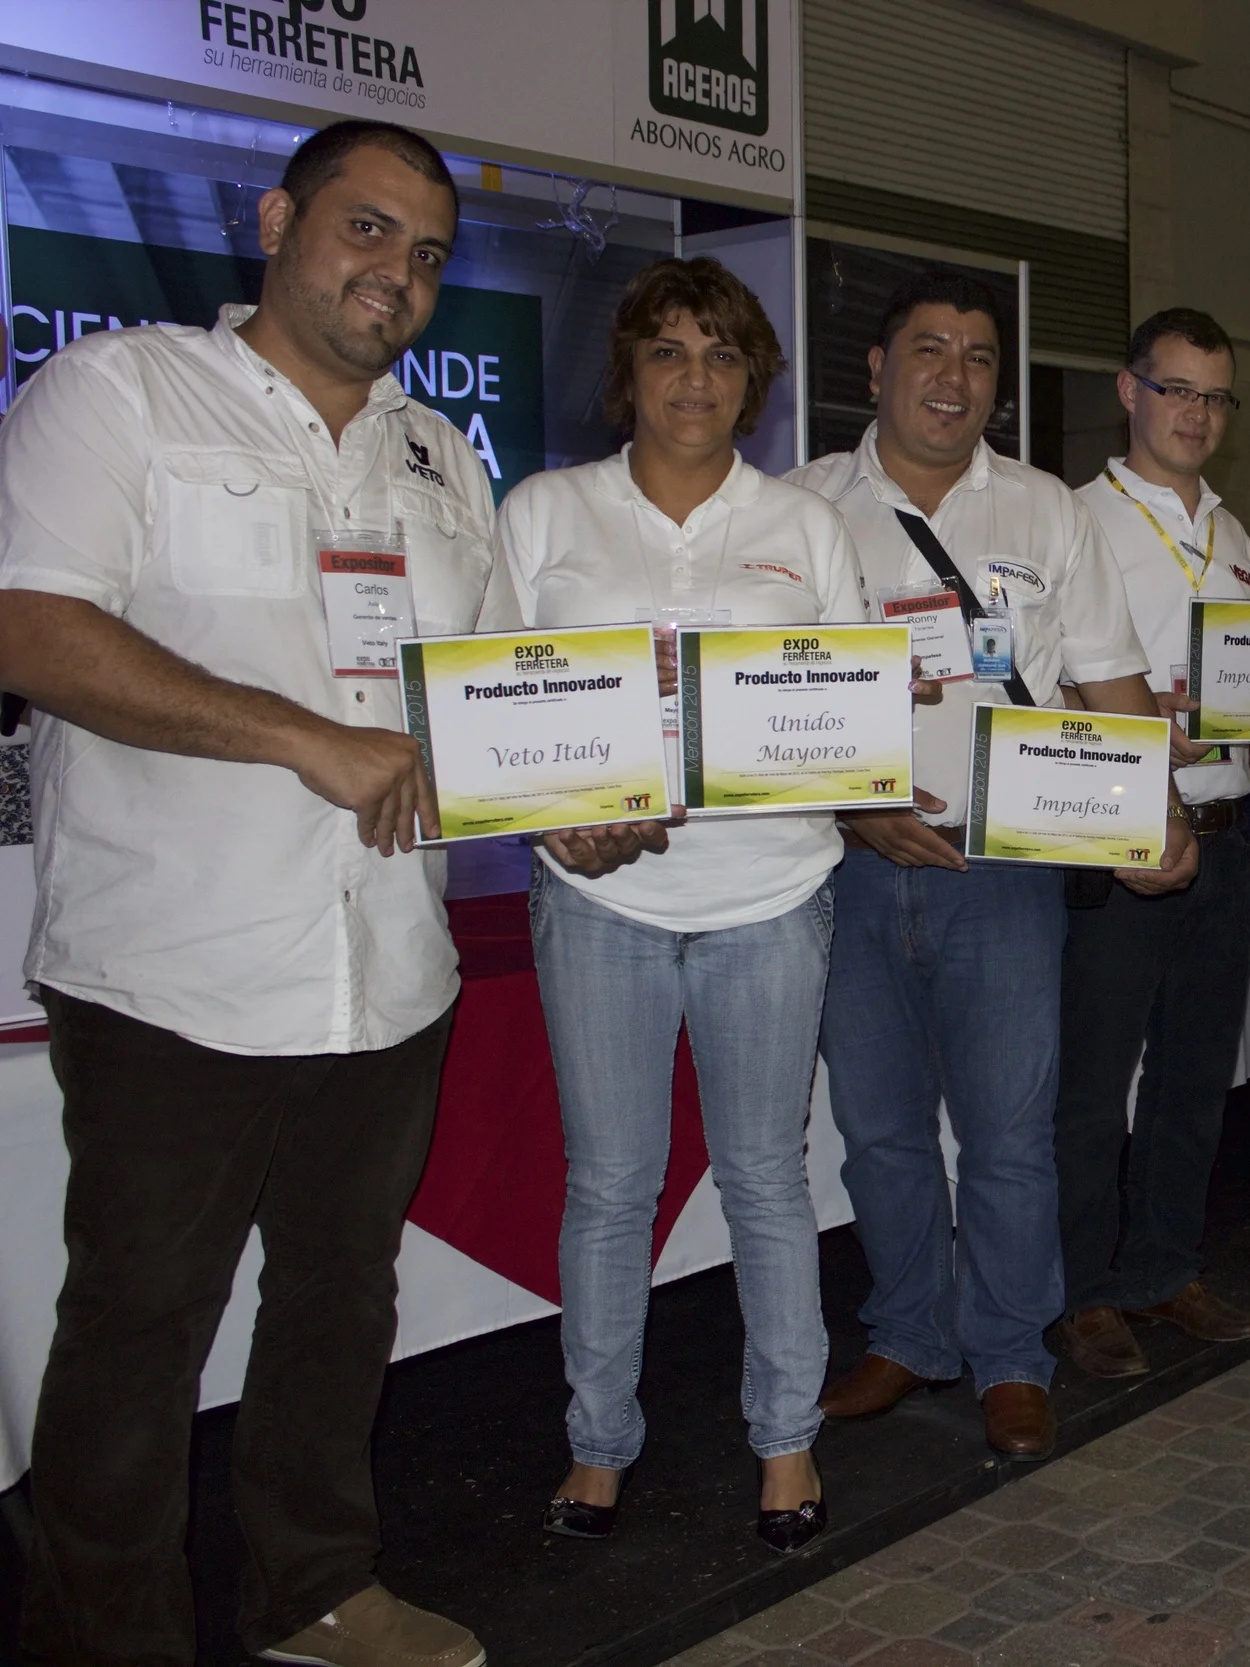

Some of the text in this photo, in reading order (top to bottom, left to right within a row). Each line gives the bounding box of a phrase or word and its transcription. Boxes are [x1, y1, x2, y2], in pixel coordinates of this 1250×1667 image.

[201, 1, 424, 88] FERRETERA
[204, 48, 426, 109] su herramienta de negocios
[663, 57, 757, 117] ACEROS
[630, 118, 785, 172] ABONOS AGRO
[405, 459, 445, 487] VETO
[331, 554, 396, 573] Expositor
[756, 564, 802, 583] TRUPER
[355, 582, 389, 596] Carlos
[893, 597, 950, 613] Expositor
[907, 615, 938, 625] Ronny
[514, 643, 554, 661] expo
[782, 651, 832, 661] FERRETERA
[783, 638, 819, 653] expo
[515, 658, 569, 671] FERRETERA
[1190, 627, 1201, 700] ención 2015
[464, 675, 622, 700] Producto Innovador
[735, 669, 880, 685] Producto Innovador
[406, 680, 426, 726] 2015
[683, 665, 699, 773] Mención 2015
[767, 711, 846, 733] Unidos
[1061, 719, 1092, 733] expo
[1060, 731, 1102, 743] FERRETERA
[487, 736, 611, 769] Veto Italy
[756, 744, 857, 767] Mayoreo
[1019, 743, 1076, 760] Producto
[1080, 748, 1142, 764] Innovador
[871, 778, 897, 794] TYT
[971, 733, 988, 826] Mención 2015
[624, 794, 652, 811] TYT
[1033, 796, 1121, 818] Impafesa
